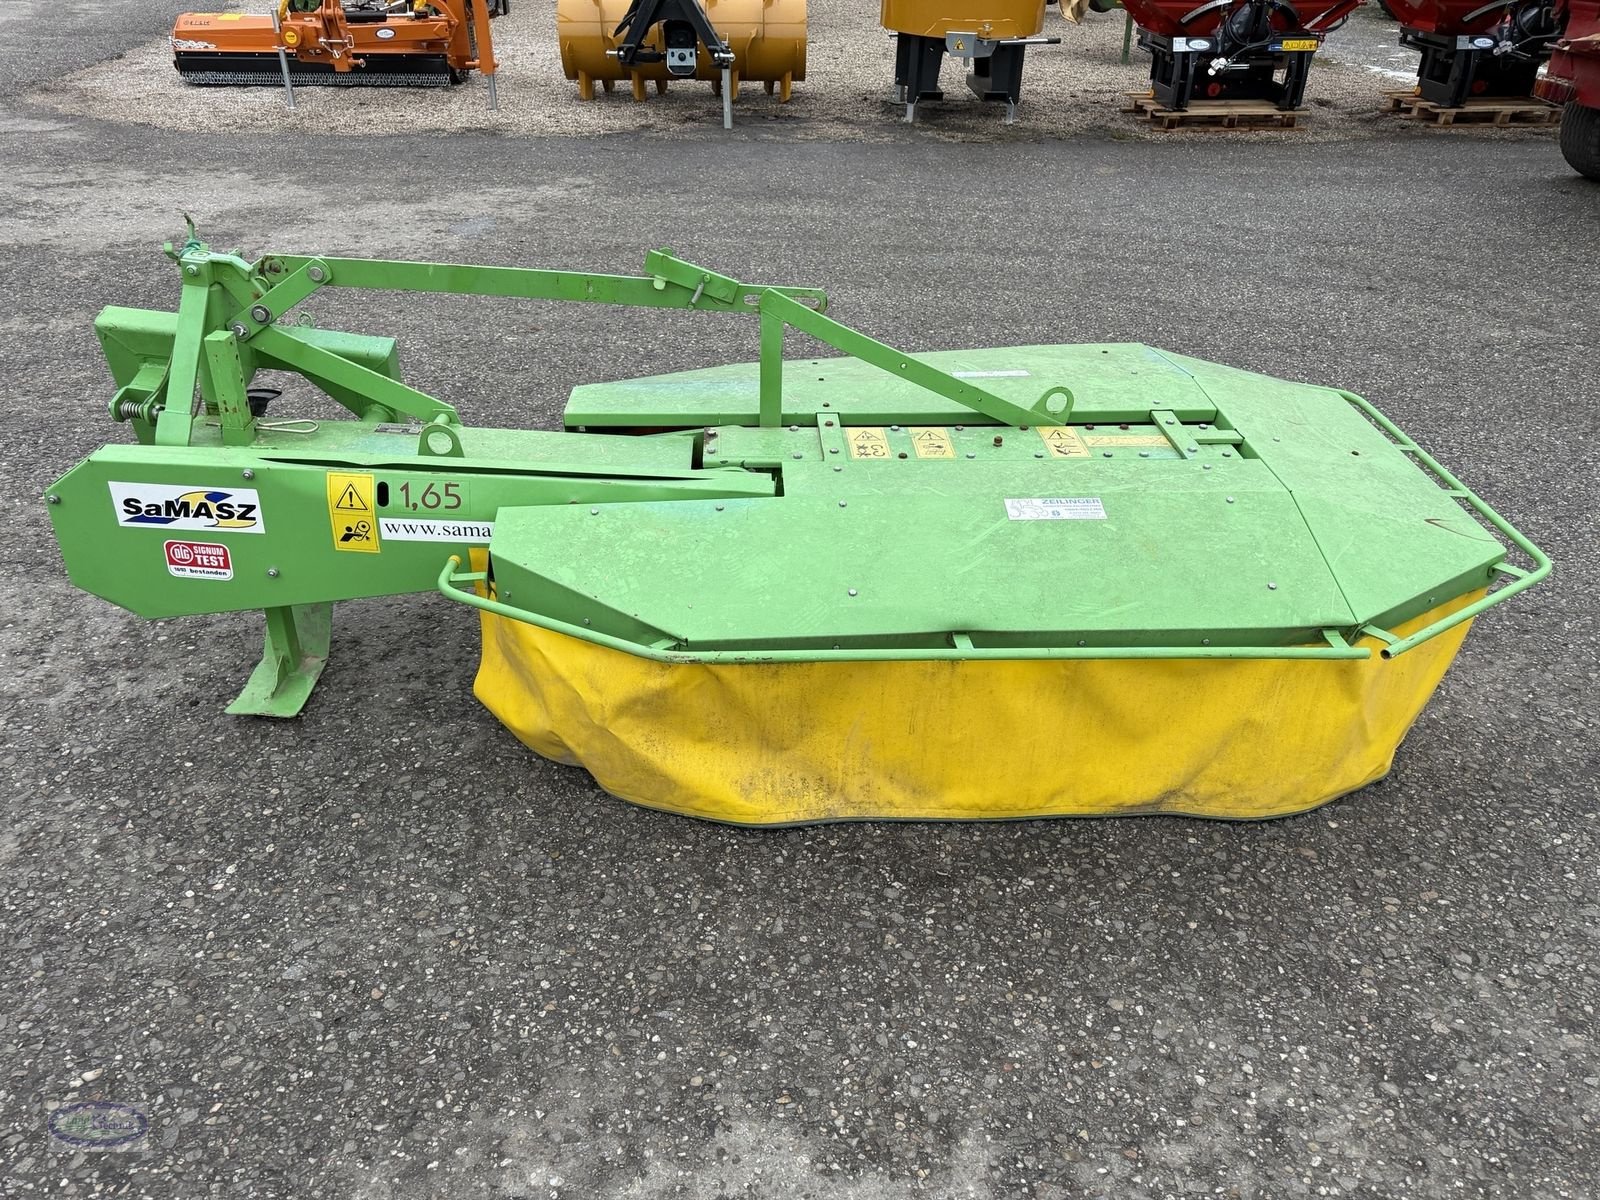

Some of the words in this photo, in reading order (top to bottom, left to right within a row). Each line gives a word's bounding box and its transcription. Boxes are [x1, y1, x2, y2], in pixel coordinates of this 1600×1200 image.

[400, 481, 462, 511] 1,65
[123, 498, 257, 520] SaMASZ
[384, 523, 492, 538] www.sama
[193, 545, 224, 555] SIGNUM
[194, 554, 225, 567] TEST
[190, 567, 228, 576] bestanden
